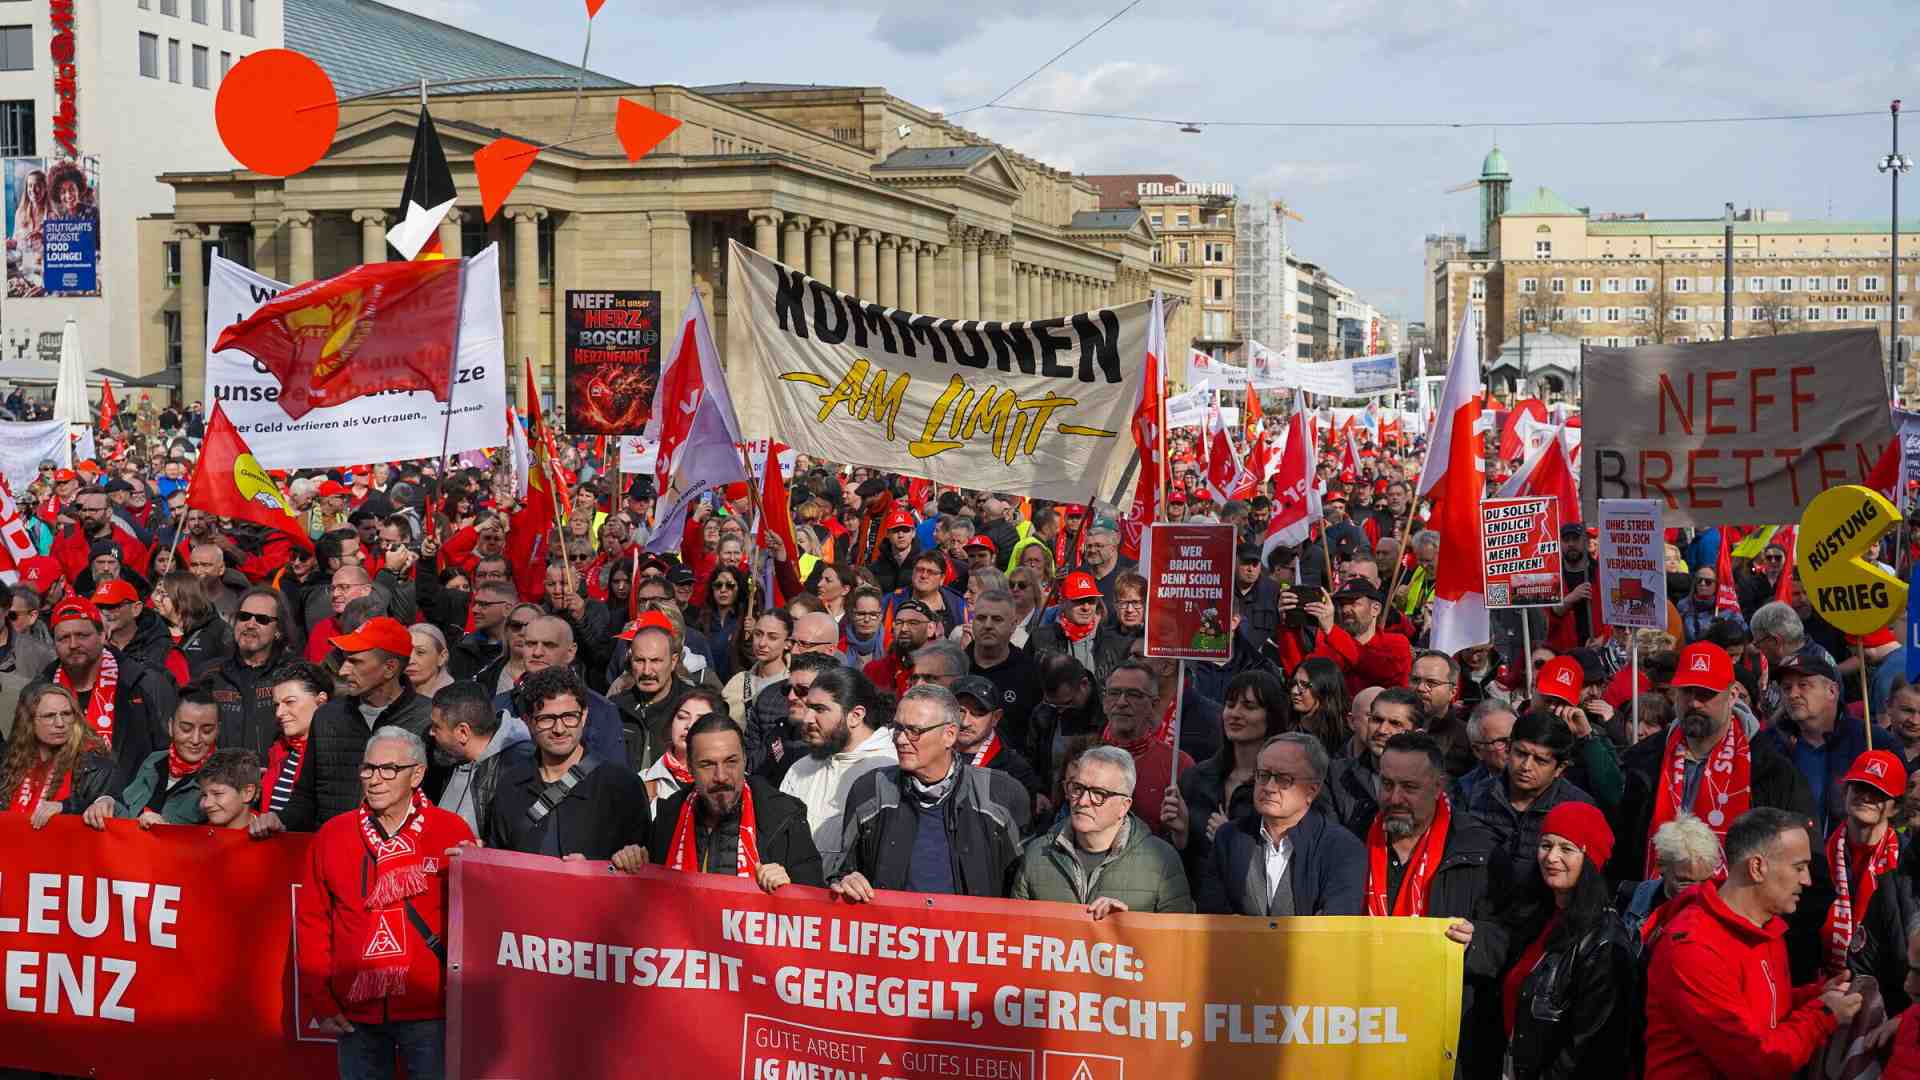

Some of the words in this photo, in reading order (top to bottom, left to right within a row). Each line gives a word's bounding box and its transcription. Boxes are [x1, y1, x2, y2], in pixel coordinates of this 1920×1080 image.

[46, 223, 92, 233] STUTTGARTS
[46, 242, 69, 252] FOOD
[46, 252, 82, 261] LOUNGE!
[572, 293, 615, 309] NEFF
[1846, 294, 1905, 304] BRAUHAS
[585, 309, 641, 329] HERZ
[774, 264, 1123, 384] KOMMUNEN
[580, 330, 641, 346] BOSCH
[574, 347, 651, 365] HERZINFARKT
[1658, 366, 1816, 435] NEFF
[818, 358, 911, 441] AM
[908, 373, 1078, 465] LIMIT
[254, 422, 283, 433] Geld
[286, 418, 340, 432] verlieren
[343, 415, 359, 429] als
[1486, 509, 1500, 520] DU
[1502, 503, 1542, 518] SOLLST
[1487, 518, 1531, 534] ENDLICH
[1605, 520, 1625, 530] OHNE
[1627, 520, 1655, 531] STREIK
[1487, 533, 1527, 547] WIEDER
[1610, 532, 1630, 544] WIRD
[1632, 533, 1650, 544] SICH
[1807, 497, 1879, 571] RÜSTUNG
[1181, 546, 1203, 558] WER
[1488, 548, 1519, 561] MEHR
[1540, 542, 1557, 554] #11
[1617, 546, 1643, 557] NICHTS
[1169, 559, 1212, 572] BRAUCHT
[1488, 558, 1543, 575] STREIKEN!
[1161, 573, 1186, 585] DENN
[1188, 574, 1220, 585] SCHON
[1157, 587, 1223, 599] KAPITALISTEN
[1817, 581, 1889, 613] KRIEG
[0, 872, 181, 949] LEUTE
[722, 908, 821, 950] KEINE
[830, 918, 1144, 982] LIFESTYLE-FRAGE:
[5, 950, 137, 1023] ENZ
[497, 931, 742, 993] ARBEITSZEIT
[775, 966, 984, 1029] GEREGELT,
[993, 985, 1193, 1049] GERECHT,
[1204, 1003, 1408, 1044] FLEXIBEL
[755, 1027, 801, 1052] GUTE
[807, 1037, 868, 1063] ARBEIT
[903, 1051, 961, 1076] GUTES
[966, 1055, 1023, 1080] LEBEN
[754, 1057, 780, 1080] IG
